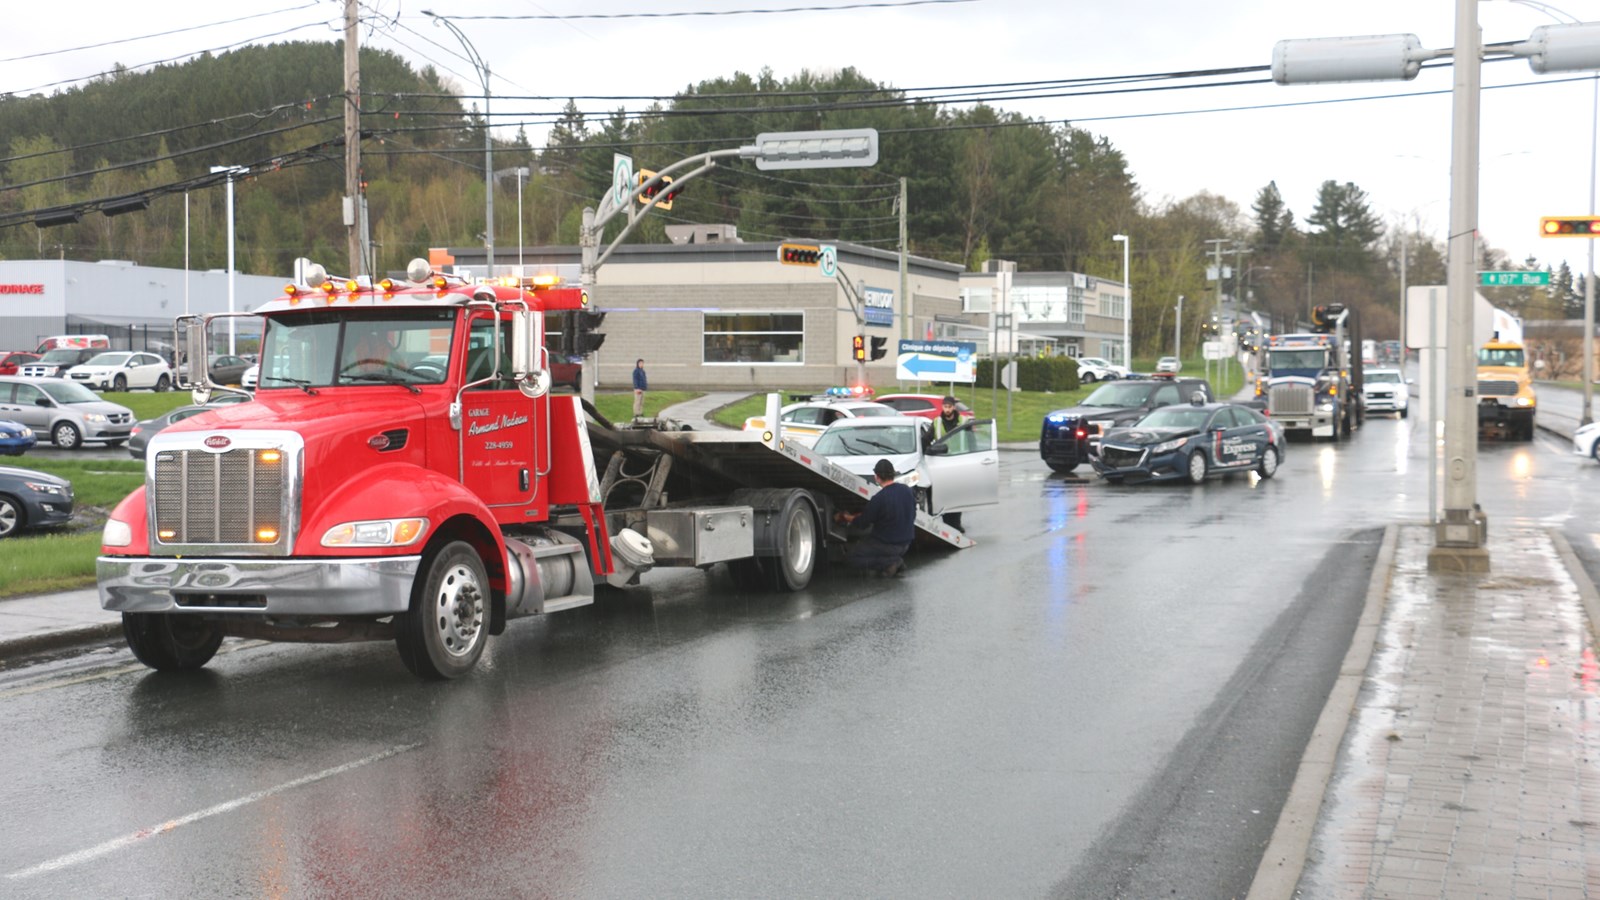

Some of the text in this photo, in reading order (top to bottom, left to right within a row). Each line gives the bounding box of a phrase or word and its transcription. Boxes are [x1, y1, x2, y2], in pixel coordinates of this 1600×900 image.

[1522, 274, 1541, 284] Rue
[902, 343, 924, 351] Clinique
[932, 345, 959, 353] dépistage
[468, 408, 489, 417] GARAGE
[468, 411, 528, 436] Armand Nadeau
[1223, 443, 1257, 455] Express
